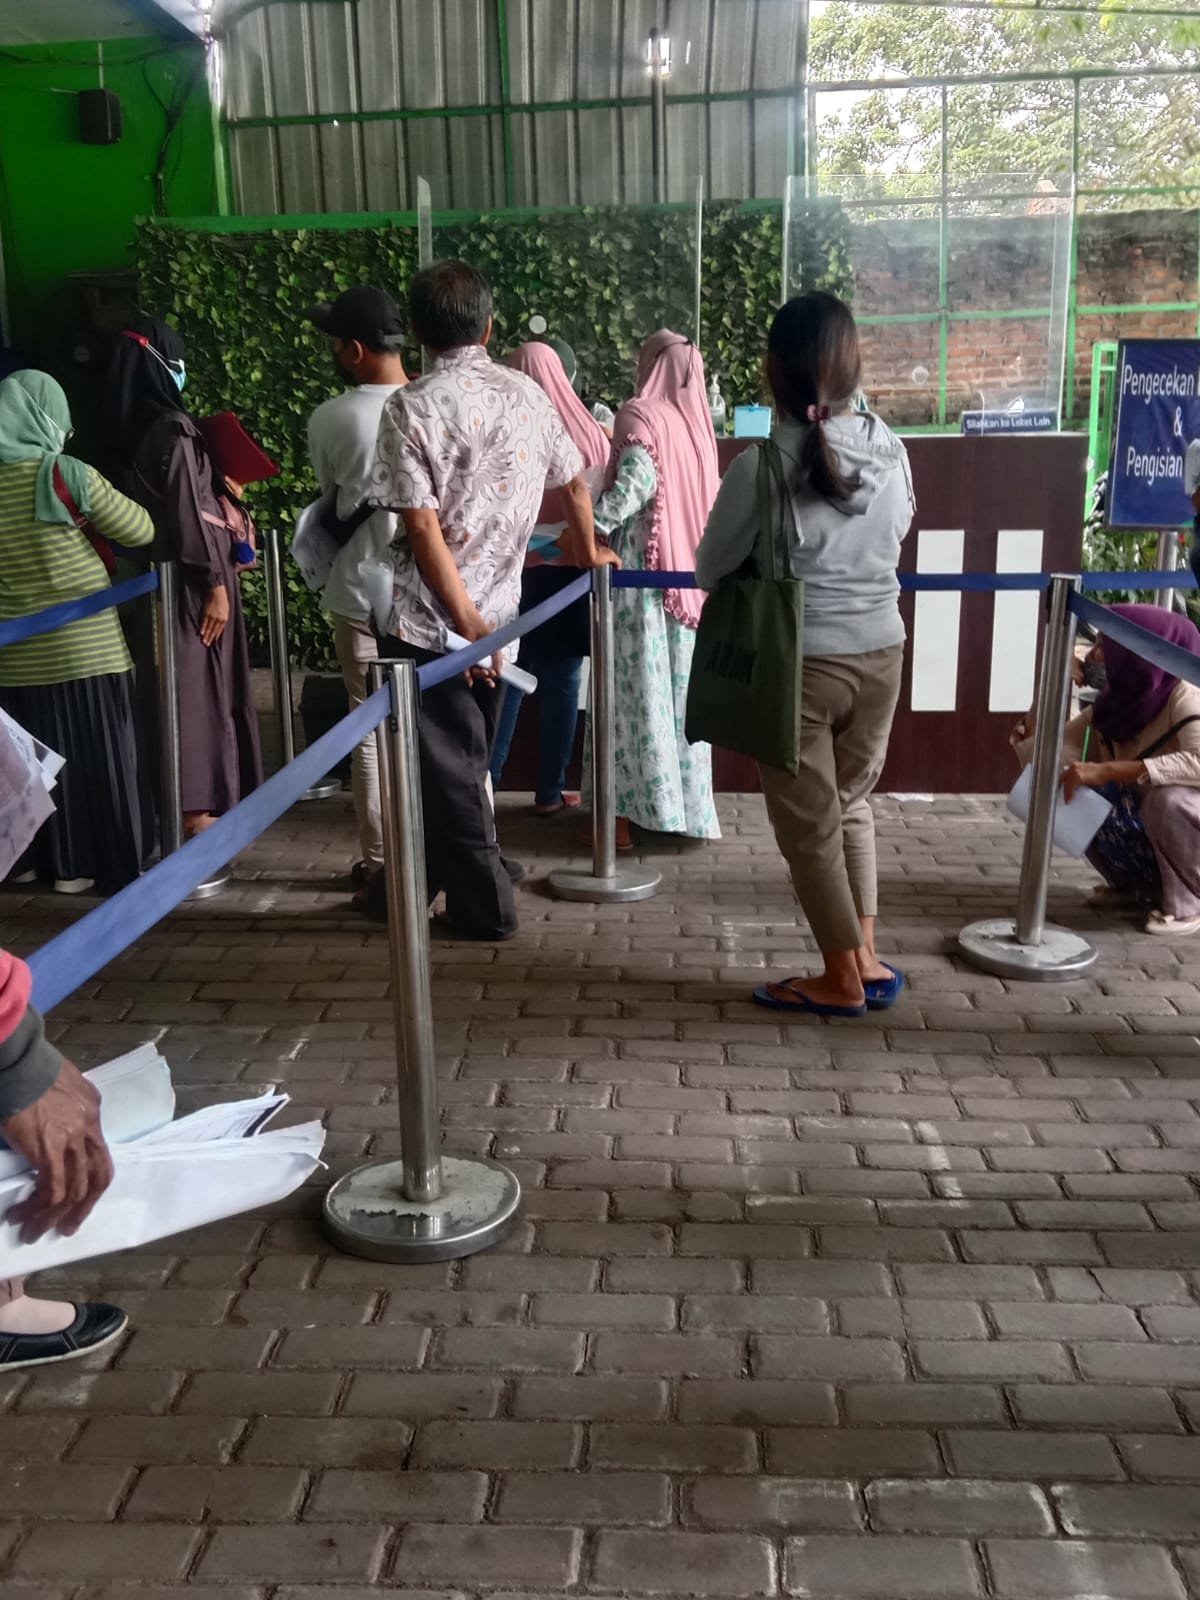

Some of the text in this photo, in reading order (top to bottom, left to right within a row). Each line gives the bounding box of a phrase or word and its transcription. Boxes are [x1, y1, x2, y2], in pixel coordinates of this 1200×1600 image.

[1123, 364, 1195, 405] Pengecekan
[1000, 417, 1010, 428] ke
[1011, 417, 1033, 427] Loket
[1034, 415, 1051, 426] Lain
[1173, 405, 1183, 437] &
[1126, 445, 1184, 486] Pengisian
